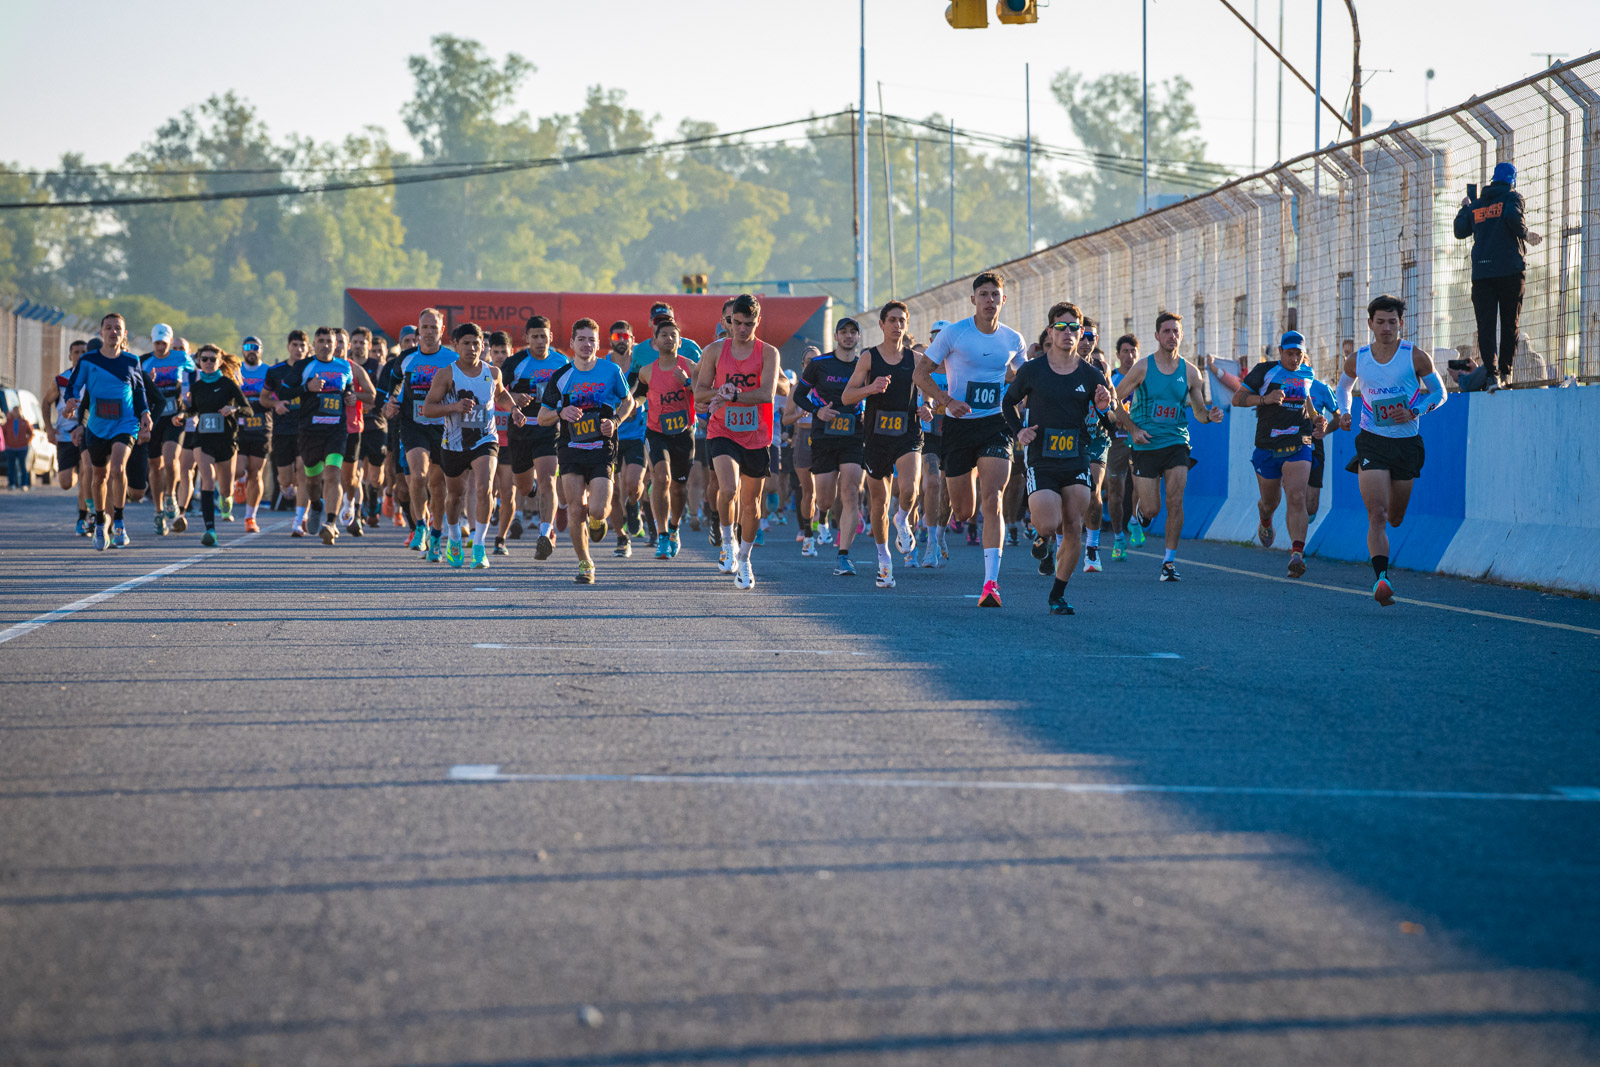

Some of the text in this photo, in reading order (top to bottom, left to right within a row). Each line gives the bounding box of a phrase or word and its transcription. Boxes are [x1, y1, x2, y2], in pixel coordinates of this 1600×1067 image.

[974, 388, 996, 404] 106
[1368, 386, 1407, 395] RUNNEA
[1156, 405, 1176, 418] 344
[205, 417, 216, 428] 21
[665, 416, 685, 431] 712
[730, 412, 752, 426] 313
[831, 417, 849, 431] 782
[880, 416, 902, 430] 718
[574, 418, 596, 435] 707
[1050, 435, 1074, 451] 706
